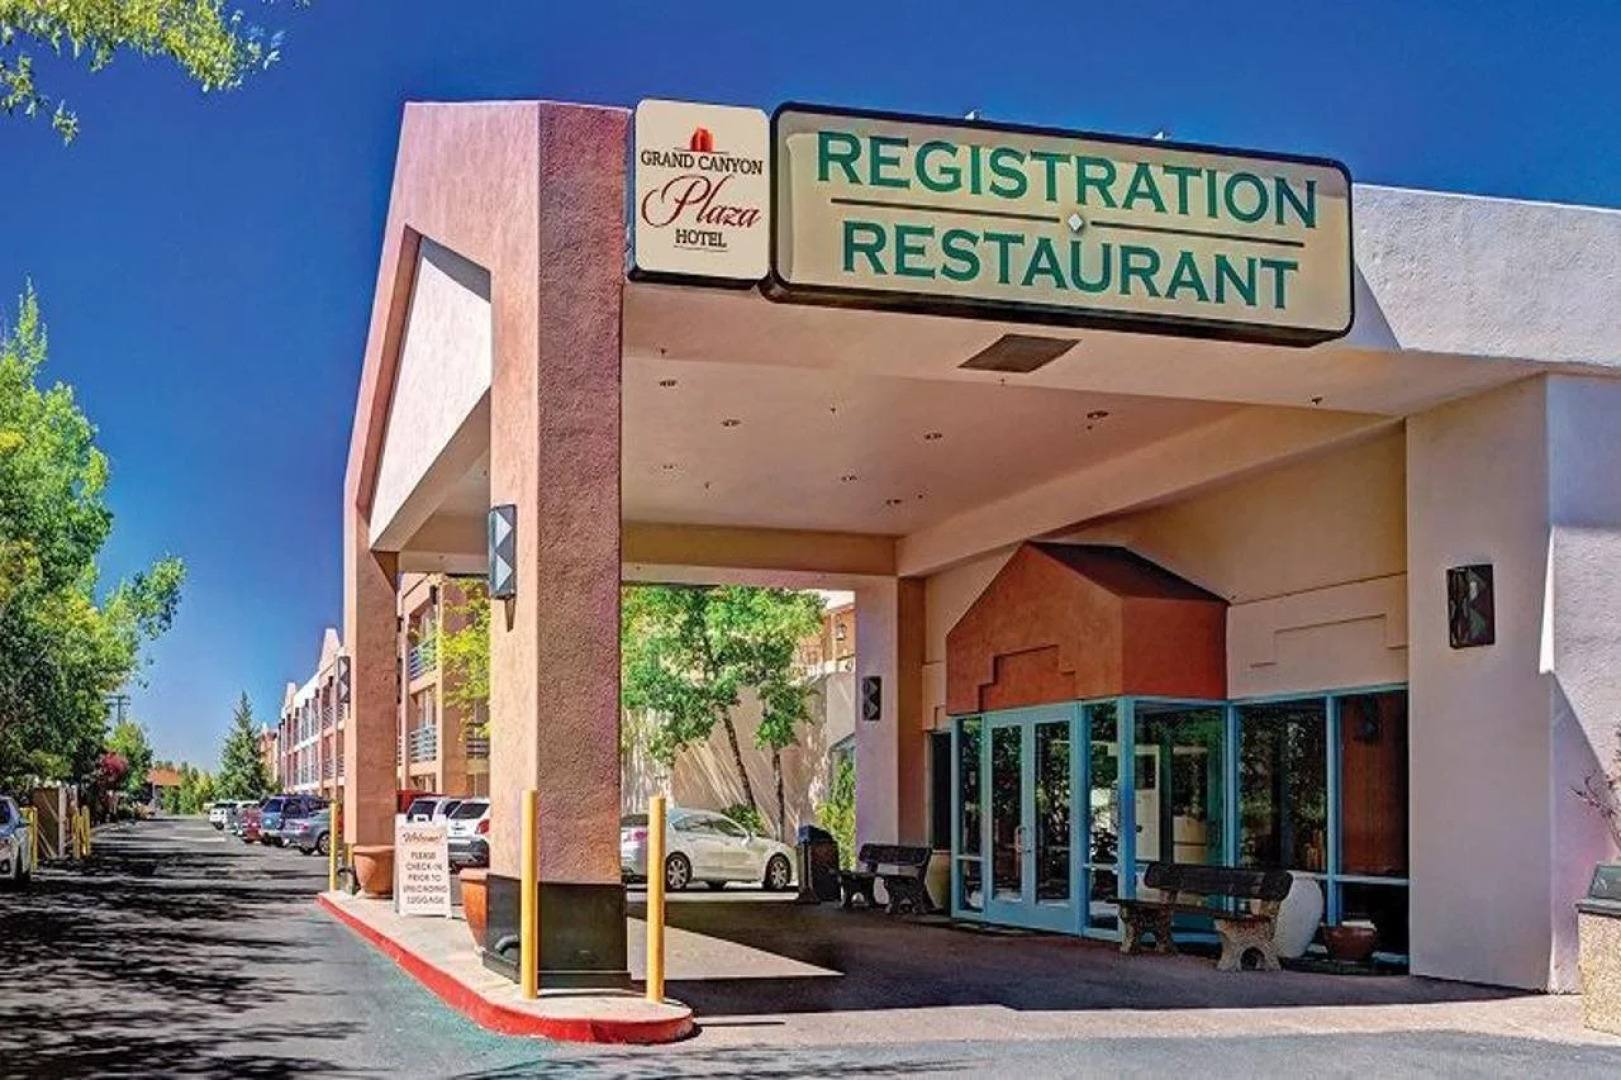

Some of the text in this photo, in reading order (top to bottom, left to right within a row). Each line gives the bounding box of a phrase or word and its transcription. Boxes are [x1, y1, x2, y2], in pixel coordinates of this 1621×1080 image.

[641, 151, 764, 175] GRAND CANYON
[817, 131, 1317, 229] REGISTRATION
[641, 174, 762, 228] Plaza
[675, 229, 727, 248] HOTEL
[842, 220, 1299, 309] RESTAURANT
[410, 851, 437, 860] PLEASE
[408, 874, 442, 882] PRIOR TO
[406, 895, 445, 905] LUGGAGE
